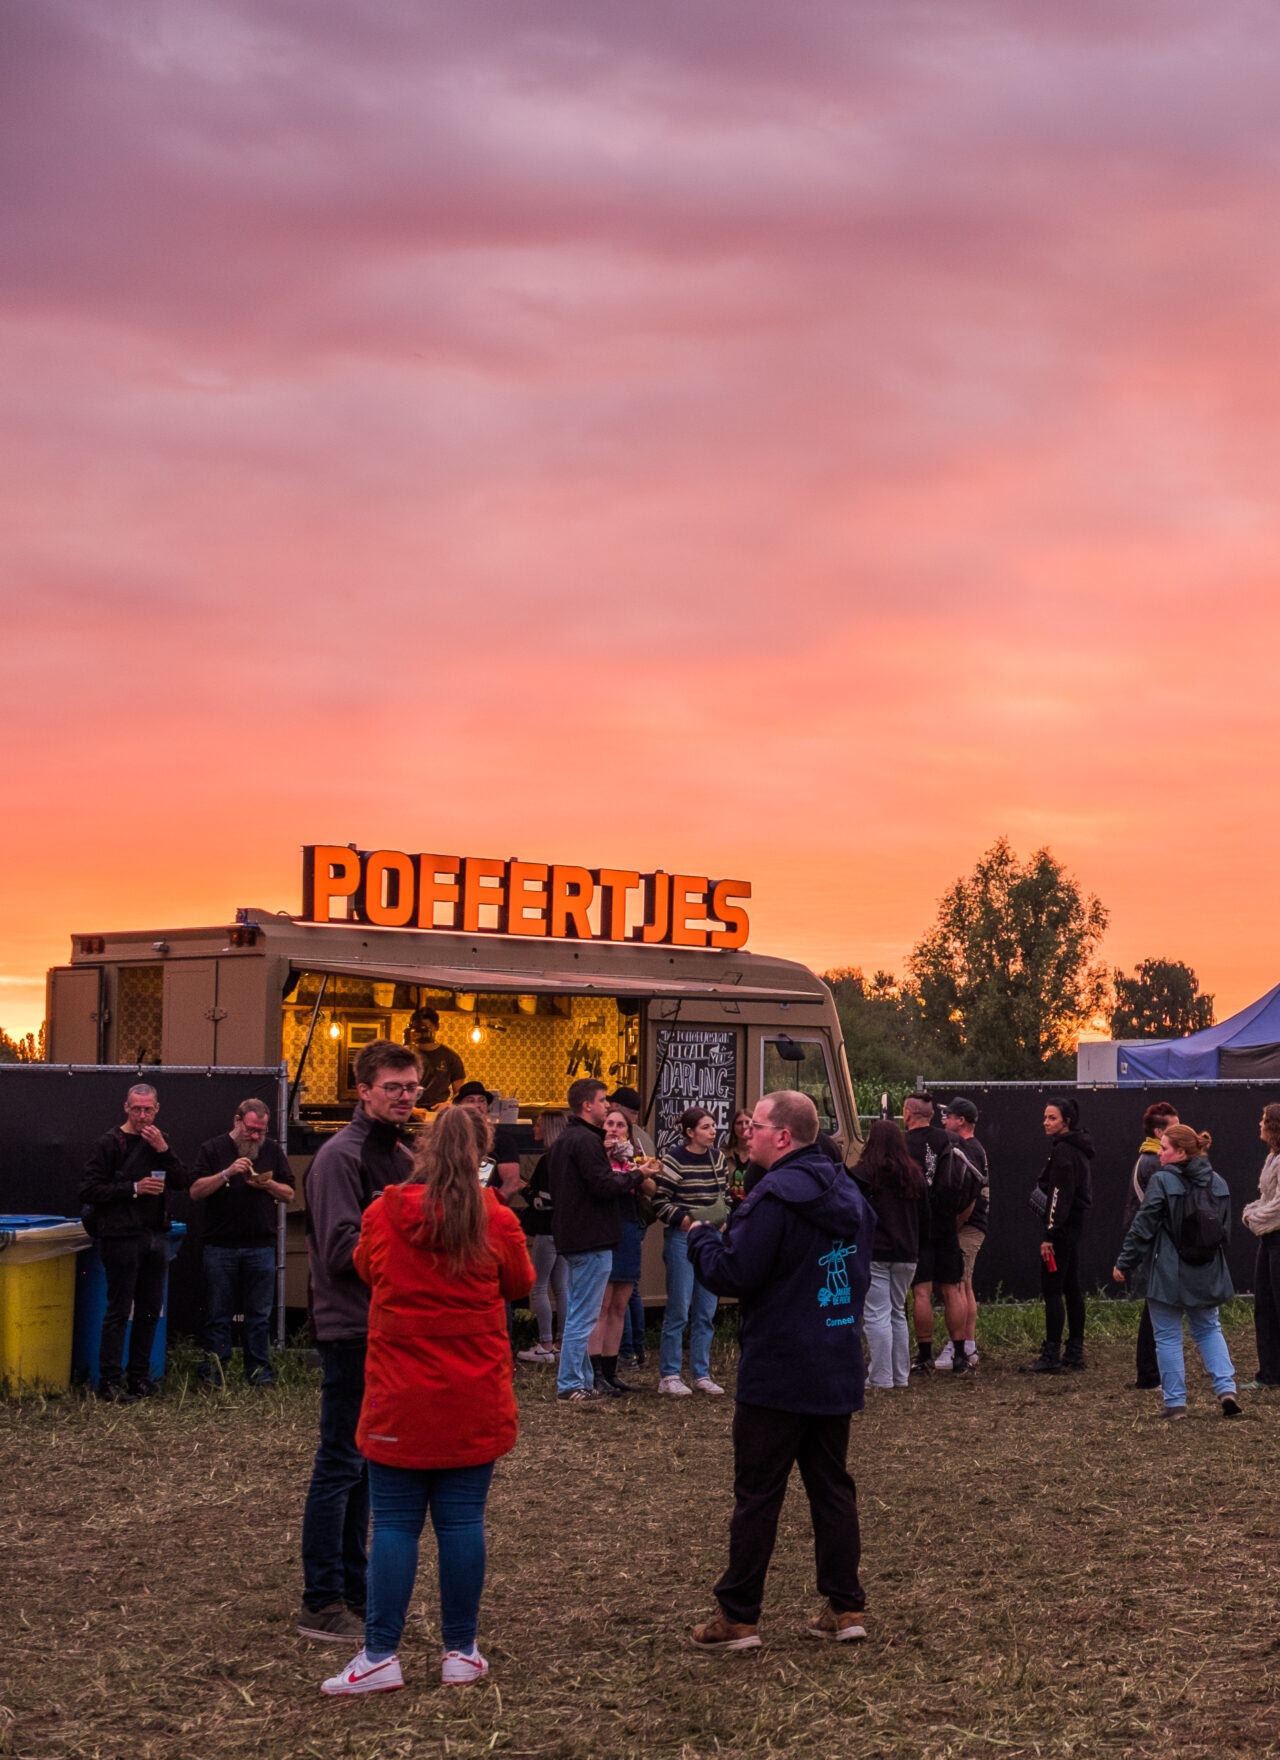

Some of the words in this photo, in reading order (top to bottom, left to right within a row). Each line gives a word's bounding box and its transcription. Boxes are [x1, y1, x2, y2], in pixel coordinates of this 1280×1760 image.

[304, 845, 752, 950] POFFERTJES
[661, 1060, 730, 1098] DARLING
[684, 1100, 730, 1129] MKE
